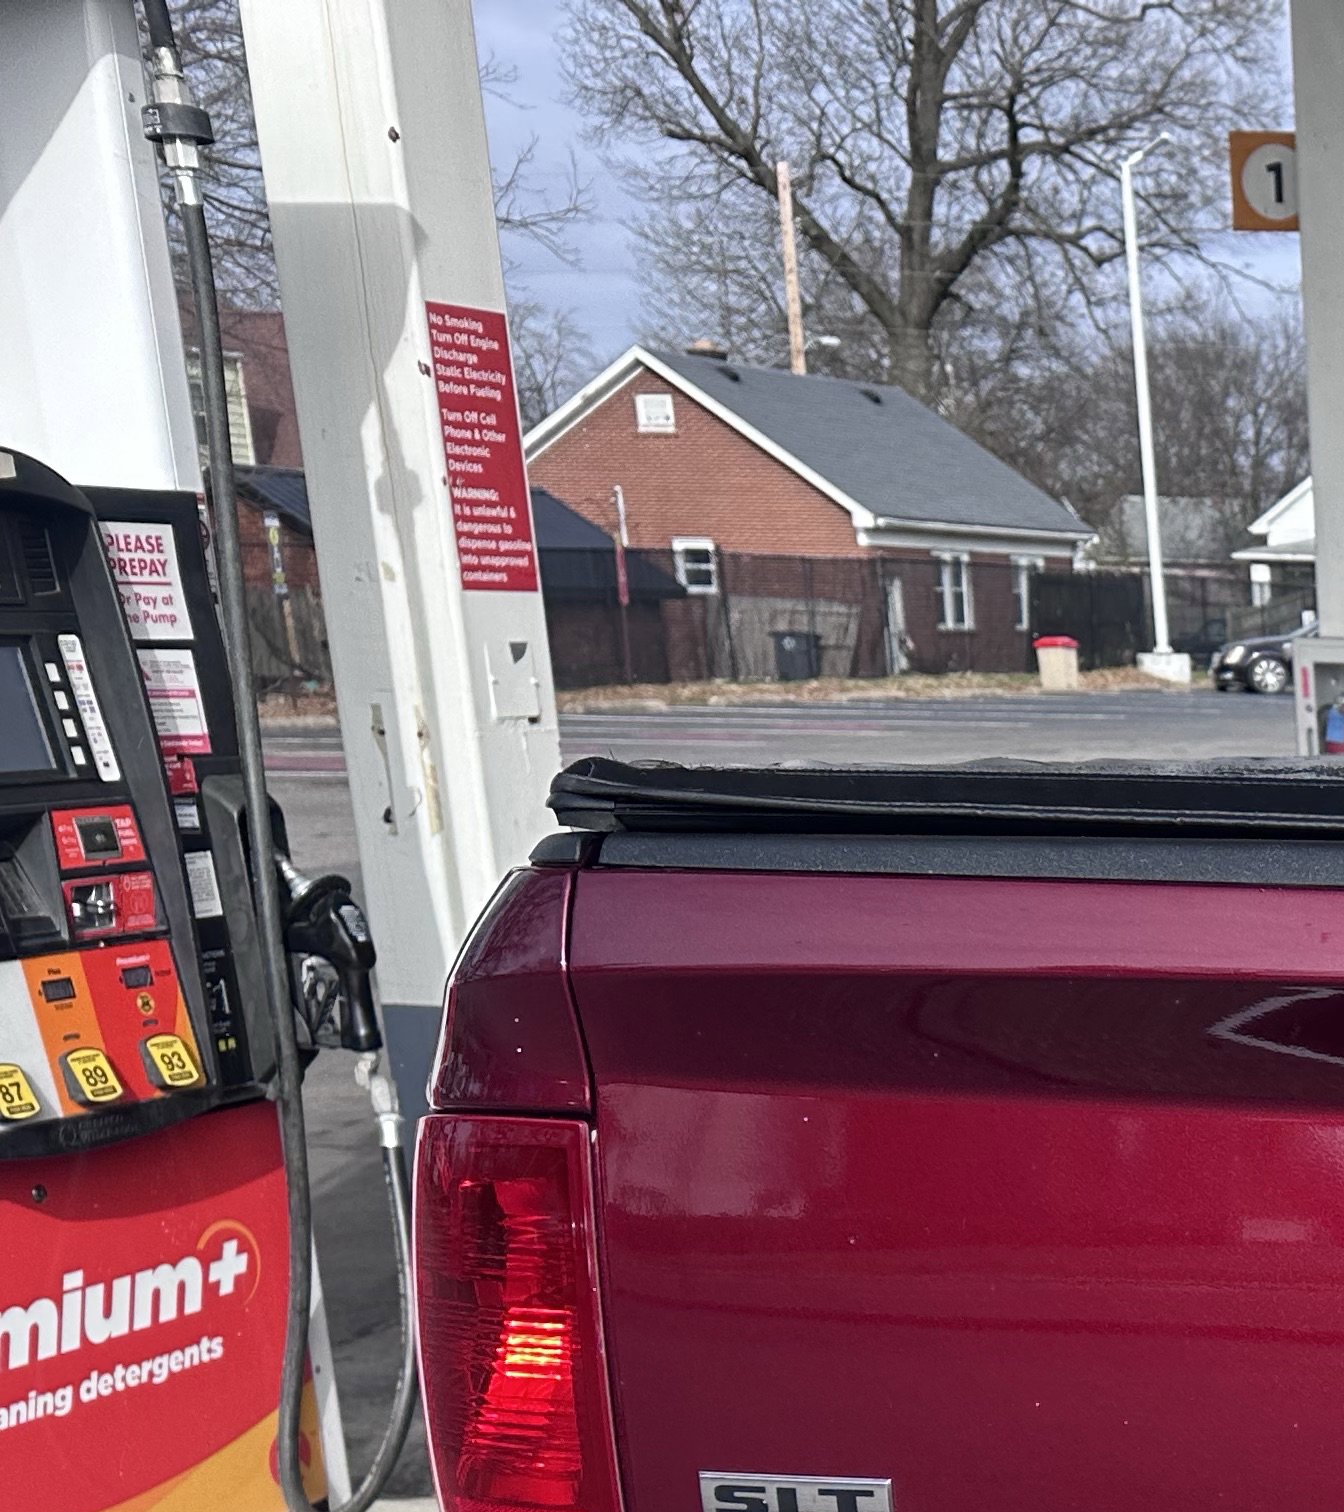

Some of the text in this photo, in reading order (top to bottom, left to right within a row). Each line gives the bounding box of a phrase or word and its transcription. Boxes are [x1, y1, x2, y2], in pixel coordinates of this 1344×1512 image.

[1265, 161, 1283, 203] 1
[429, 312, 483, 333] No Smoking
[431, 329, 499, 350] Turn Off Engine
[433, 346, 478, 365] Discharge
[436, 363, 506, 386] Static Electricity
[438, 380, 501, 402] Before Fueling
[441, 408, 496, 426] Turn Off Cell
[444, 425, 506, 443] Phone & Other
[446, 442, 491, 458] Electronic
[448, 459, 483, 473] Devices
[452, 487, 499, 501] WARNING:
[454, 503, 516, 519] It is unlawful &
[456, 520, 513, 535] dangerous to
[104, 533, 164, 554] PLEASE
[458, 536, 532, 552] dispense gasoline
[107, 557, 168, 577] PREPAY
[460, 552, 529, 567] into unapproved
[463, 570, 508, 583] containers
[134, 592, 157, 610] Pay
[162, 595, 174, 606] at
[142, 610, 177, 628] Pump
[160, 1051, 185, 1071] 93
[82, 1065, 108, 1087] 89
[0, 1082, 23, 1104] 87
[79, 1336, 224, 1404] detergents
